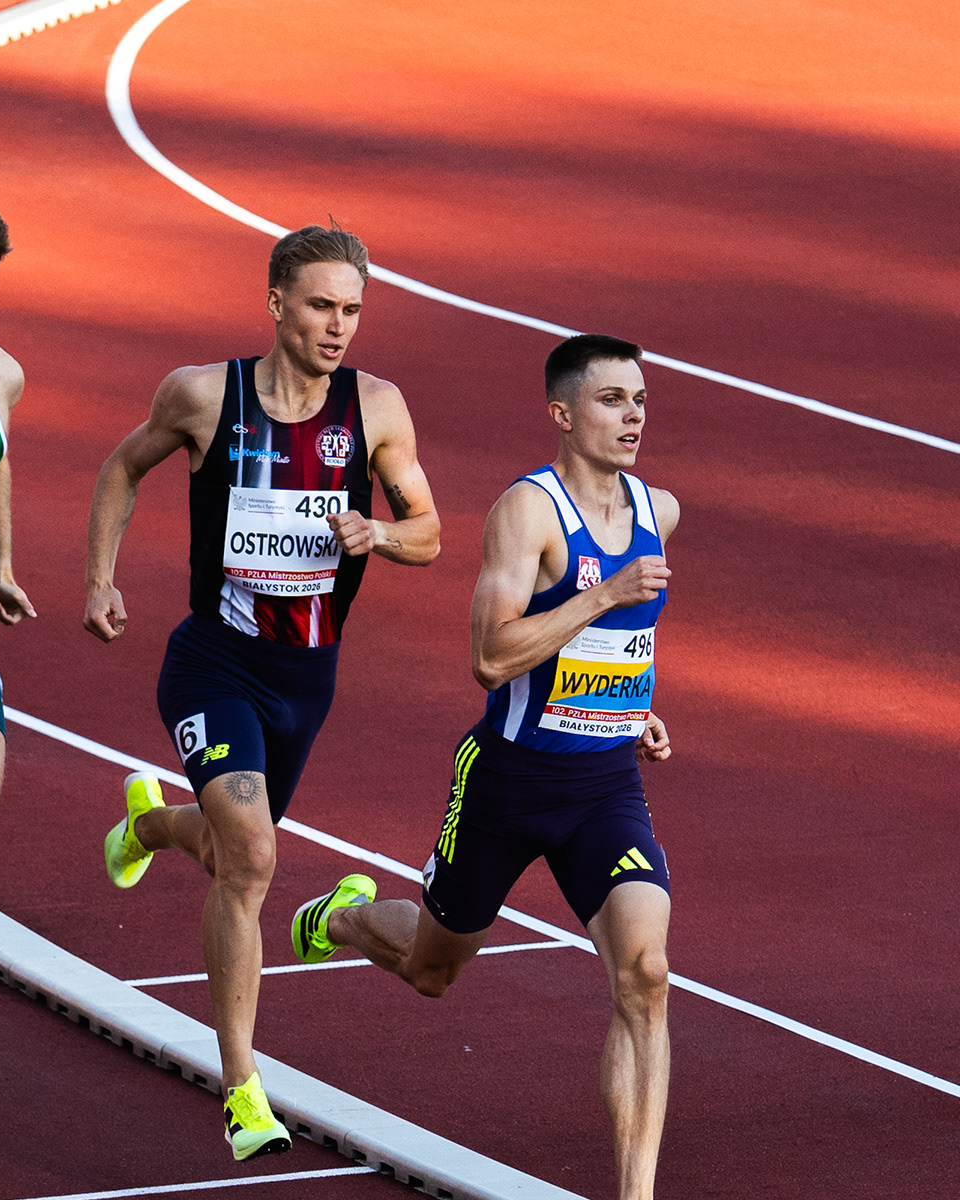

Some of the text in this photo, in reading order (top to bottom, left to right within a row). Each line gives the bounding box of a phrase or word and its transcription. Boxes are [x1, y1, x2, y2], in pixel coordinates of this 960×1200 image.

[295, 495, 341, 518] 430
[230, 568, 246, 577] 102.
[247, 570, 267, 579] PZLA
[242, 580, 321, 592] BIAŁYSTOK 2026
[623, 632, 652, 658] 496
[560, 670, 651, 699] WYDERKA
[551, 706, 566, 716] 102.
[567, 709, 587, 719] PZLA
[559, 719, 614, 733] BIAŁYSTOK
[179, 721, 197, 755] 6
